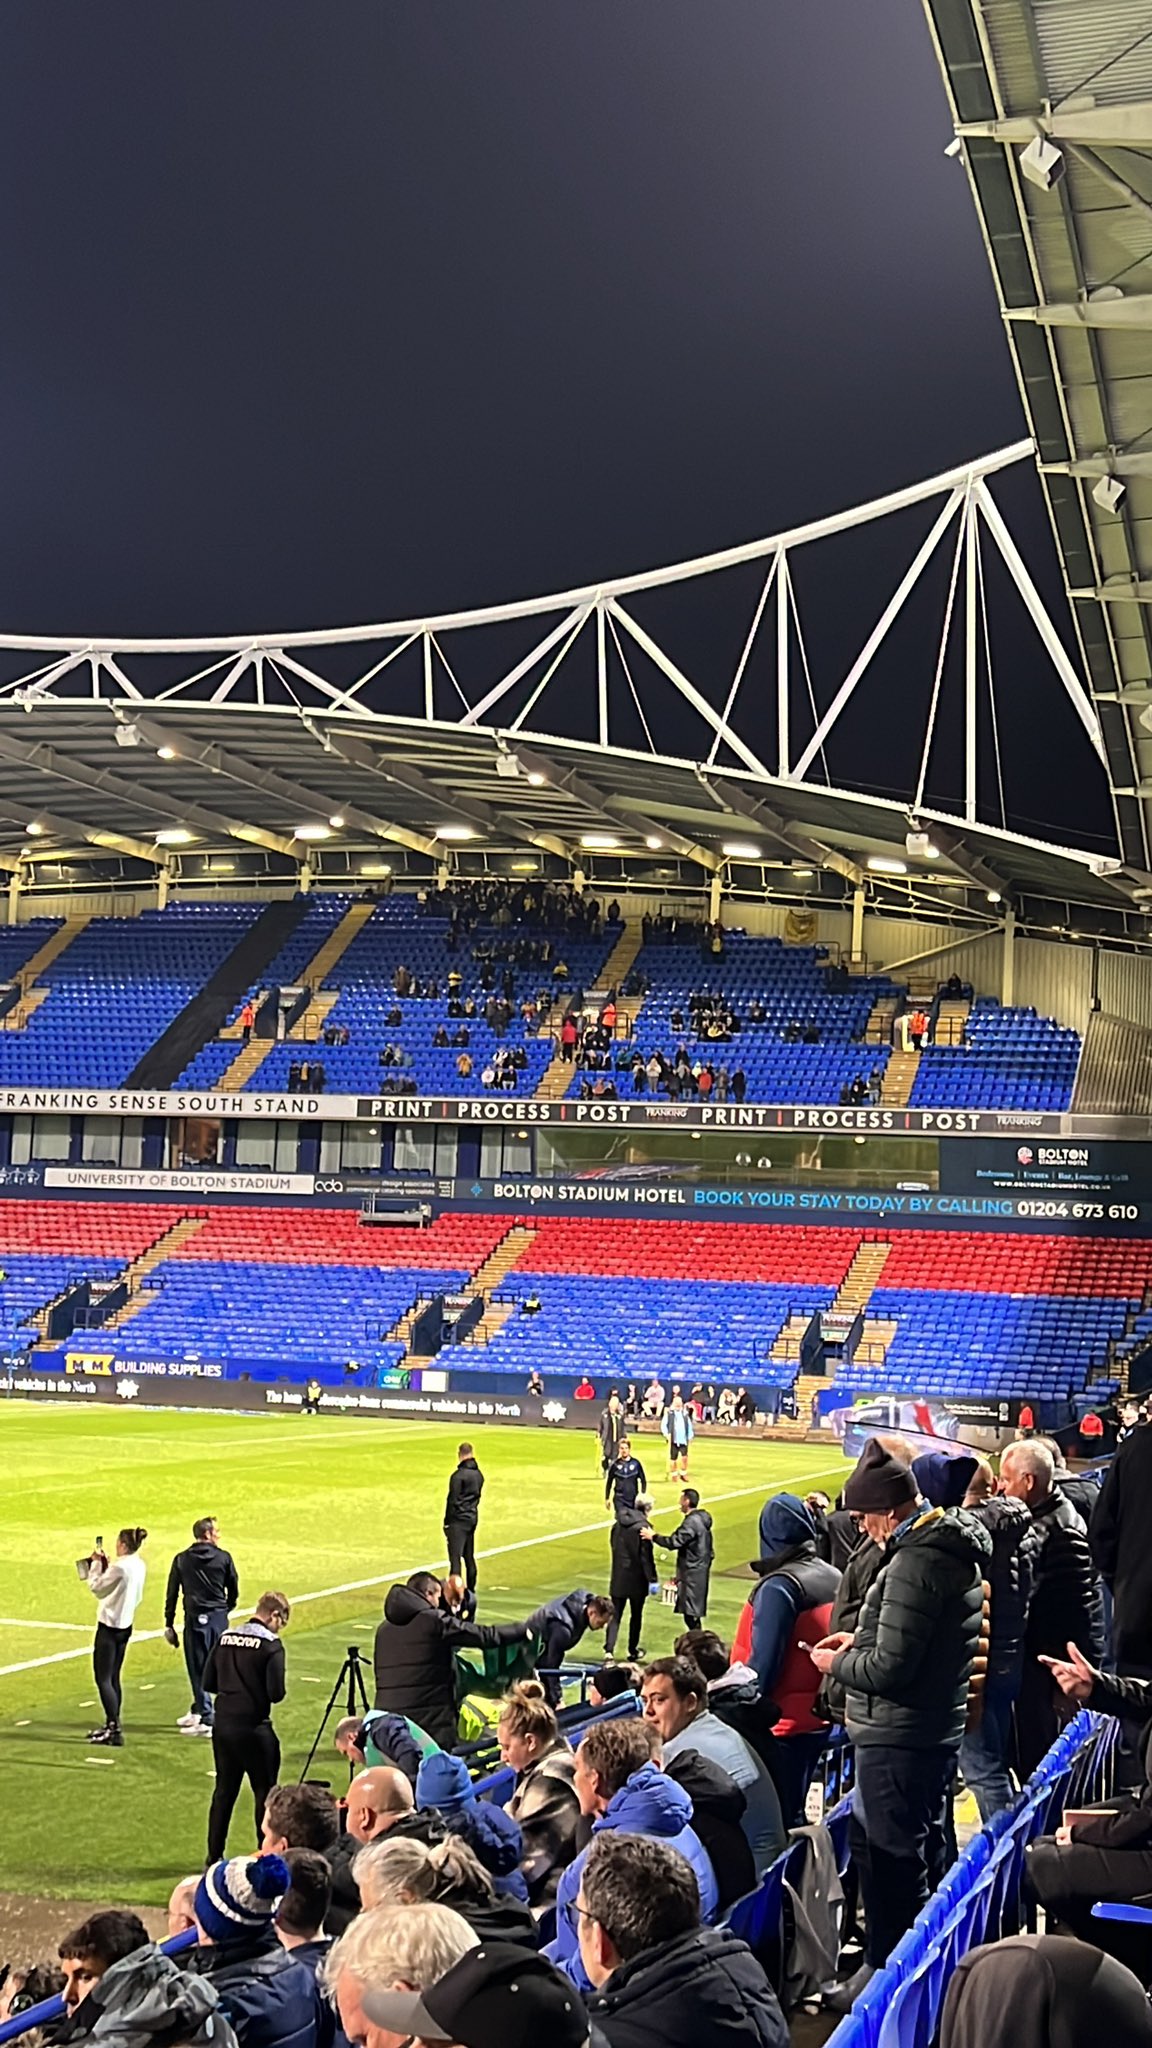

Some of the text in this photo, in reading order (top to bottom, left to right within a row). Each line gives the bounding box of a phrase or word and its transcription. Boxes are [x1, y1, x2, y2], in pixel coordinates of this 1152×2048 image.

[109, 1095, 167, 1110] SENSE
[177, 1096, 243, 1112] SOUTH
[254, 1098, 320, 1114] STAND
[371, 1102, 631, 1122] PRINT PROCESS POST
[702, 1107, 980, 1131] PRINT PROCESS POST
[1038, 1148, 1089, 1160] BOLTON
[68, 1172, 291, 1190] UNIVERSITY OF BOLTON STADIUM
[494, 1184, 686, 1204] BOLTON STADIUM HOTEL
[694, 1190, 1138, 1220] BOOK YOUR STAY TODAY BY CALLING 01204 673 610
[115, 1361, 166, 1375] BUILDING
[168, 1363, 222, 1377] SUPPLIES
[220, 1635, 261, 1649] macron
